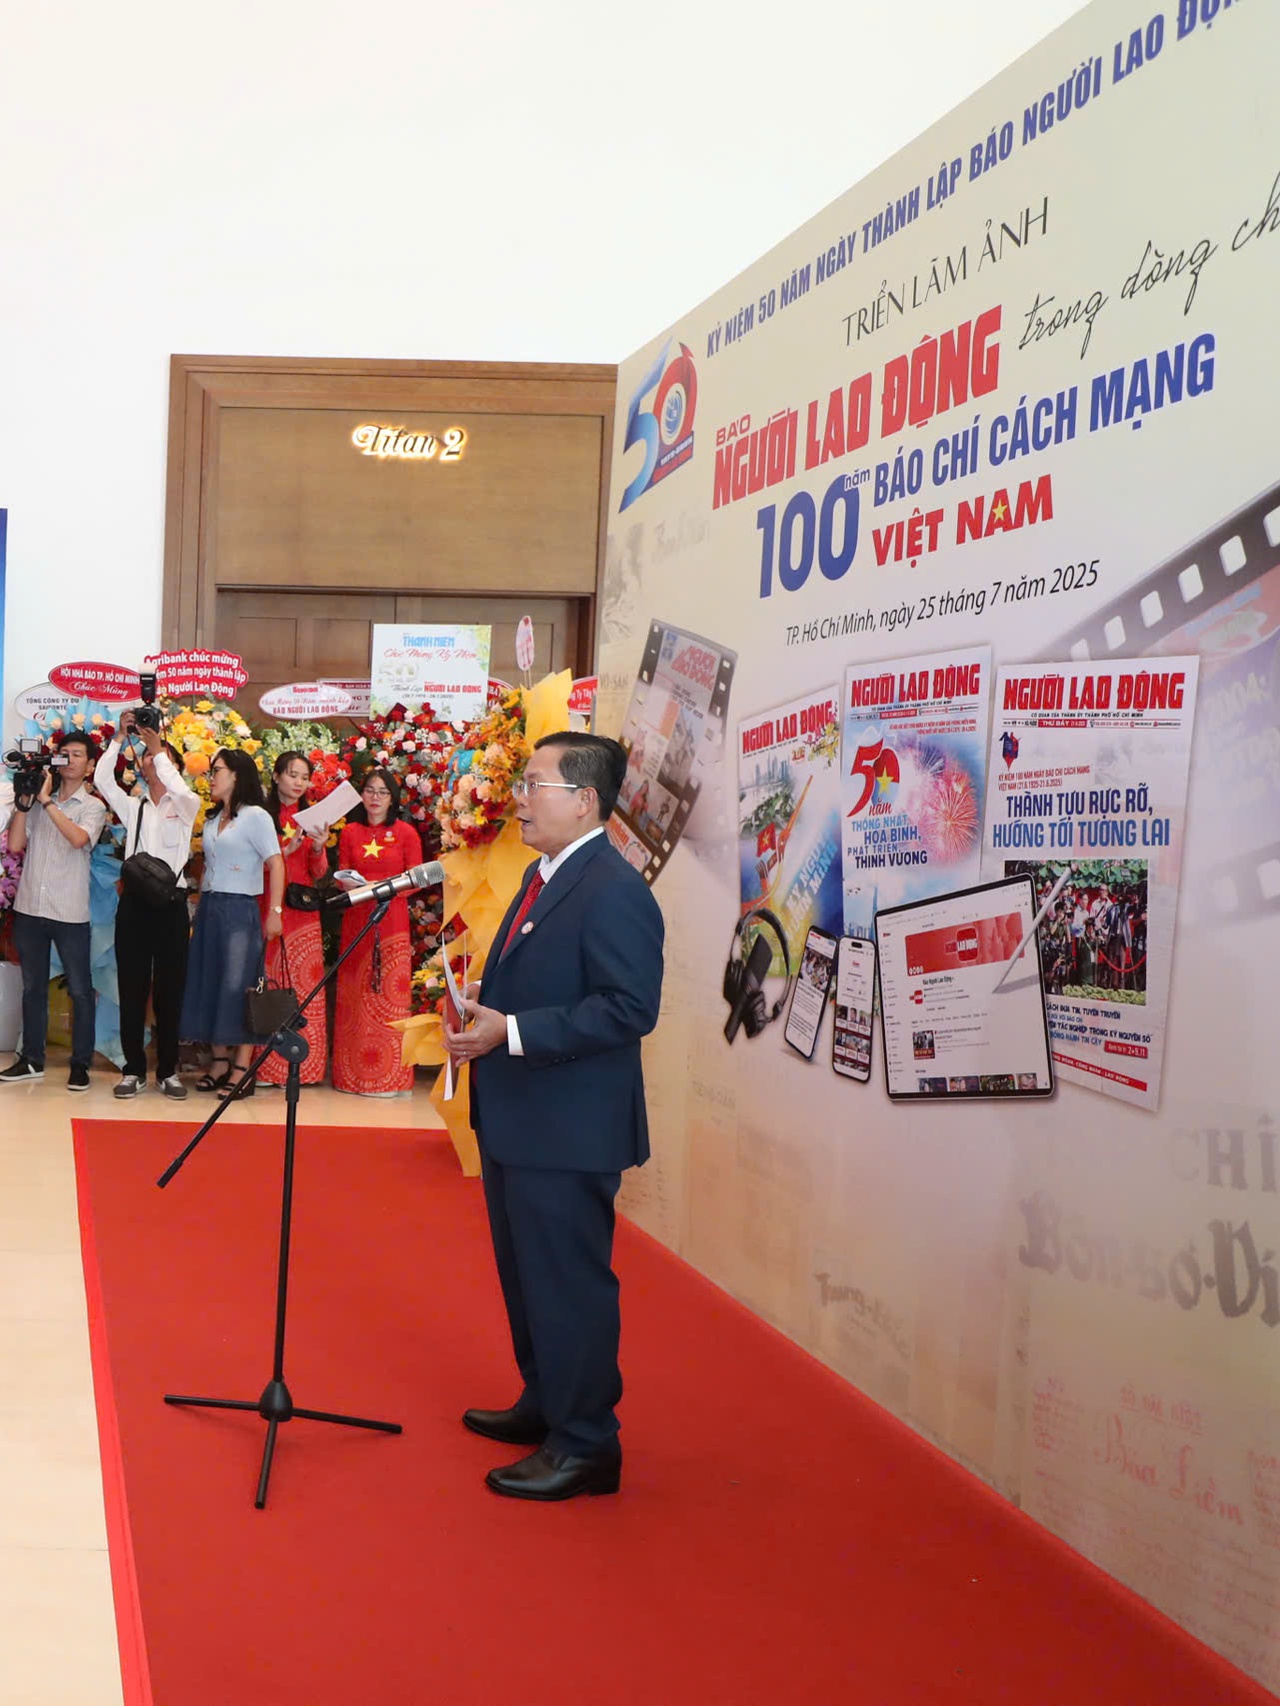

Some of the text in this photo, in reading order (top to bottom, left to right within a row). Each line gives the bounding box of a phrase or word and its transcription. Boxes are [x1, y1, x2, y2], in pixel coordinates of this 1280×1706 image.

[706, 320, 722, 358] KỶ
[724, 303, 755, 343] NIỆM
[758, 288, 776, 325] 50
[780, 263, 812, 310] NĂM
[815, 231, 857, 286] NGÀY
[862, 185, 921, 254] THÀNH
[926, 157, 962, 211] LẬP
[969, 121, 1014, 183] BÁO
[1022, 55, 1102, 147] NGƯỜI
[1112, 13, 1165, 85] LAO
[842, 196, 1048, 346] TRIỂN LÃM ẢNH
[1018, 290, 1110, 361] trong
[1120, 239, 1220, 317] dòng
[712, 304, 1002, 511] NGƯỜI LAO ĐỘNG
[874, 333, 1216, 508] BÁO CHÍ CÁCH MẠNG
[354, 424, 468, 460] Titan 2
[715, 413, 751, 448] BÁO
[756, 466, 871, 600] 100 năm
[871, 473, 1054, 569] VIỆT NAM
[786, 559, 1100, 647] TP. Hồ Chí Minh, ngày 25 tháng 7 năm 2025
[60, 667, 71, 678] HỘI
[72, 668, 84, 679] NHÀ
[84, 669, 96, 680] BÁO
[105, 671, 114, 682] HỒ
[168, 666, 246, 684] 50 năm ngày thành lập
[189, 650, 210, 662] chúc
[212, 653, 239, 669] mừng
[70, 681, 96, 692] Chúc
[168, 681, 193, 695] Người
[210, 682, 234, 697] Động
[447, 685, 461, 693] LAO
[851, 664, 981, 708] NGƯỜI LAO ĐỘNG
[1003, 670, 1186, 713] NGƯỜI LAO ĐỘNG
[273, 706, 286, 715] BÁO
[321, 705, 339, 714] ĐỘNG
[743, 720, 774, 755] NGƯỜI
[776, 713, 798, 743] LAO
[800, 699, 834, 735] ĐỘNG
[847, 737, 901, 818] 50
[869, 797, 892, 816] năm
[1006, 782, 1153, 820] THÀNH TỰU RỰC RỠ,
[992, 819, 1045, 848] HƯỚNG
[1048, 817, 1074, 848] TỚI
[1141, 818, 1171, 847] LAI
